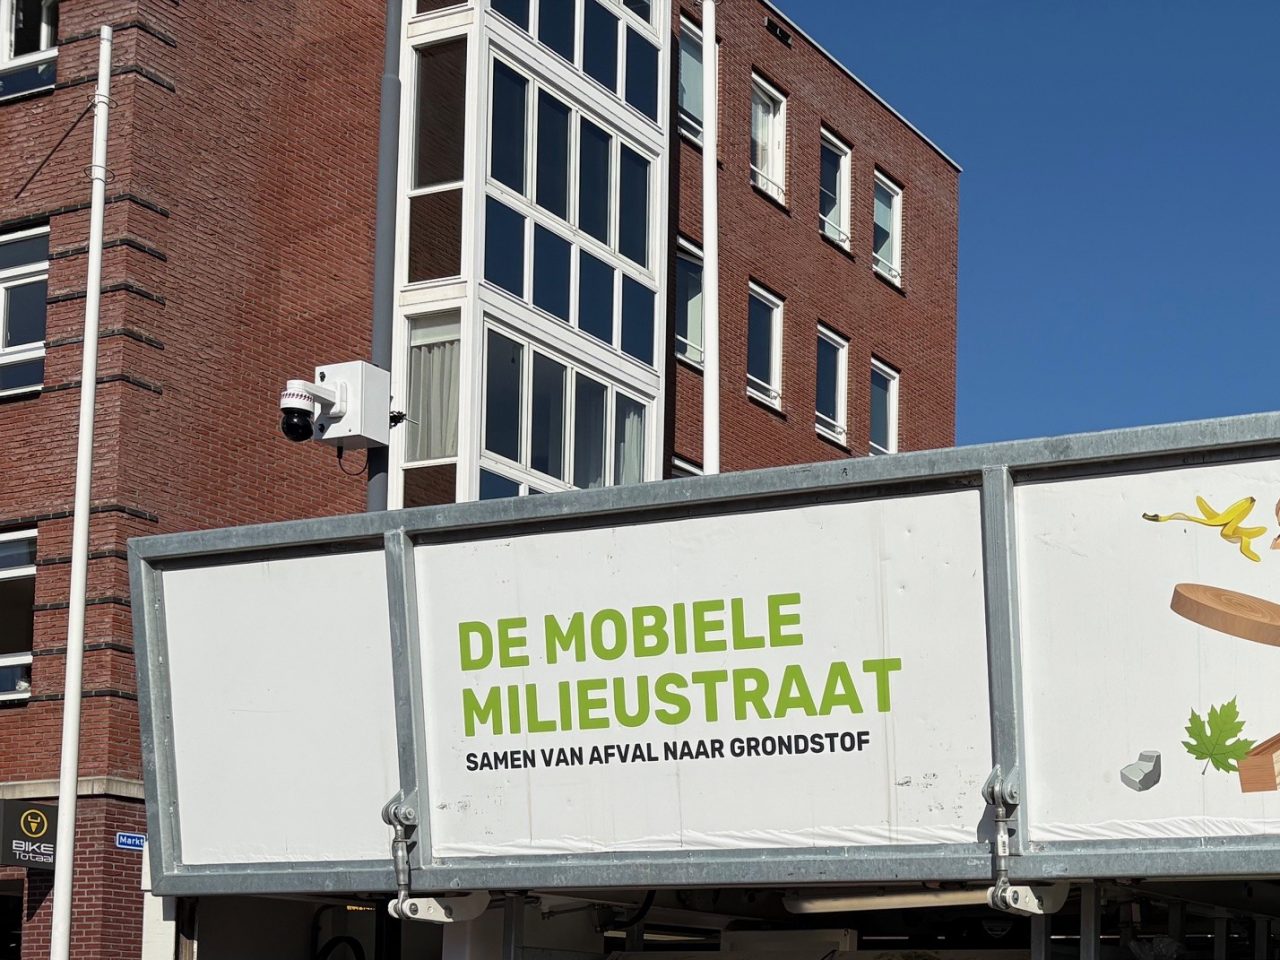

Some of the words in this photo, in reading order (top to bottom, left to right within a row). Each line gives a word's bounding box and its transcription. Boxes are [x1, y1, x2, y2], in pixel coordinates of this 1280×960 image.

[458, 616, 530, 671] DE
[544, 592, 804, 665] MOBIELE
[462, 657, 902, 737] MILIEUSTRAAT
[465, 748, 537, 772] SAMEN
[540, 745, 585, 768] VAN
[588, 742, 660, 766] AFVAL
[663, 738, 725, 761] NAAR
[729, 731, 871, 757] GRONDSTOF
[12, 840, 54, 854] BIKE
[119, 836, 144, 846] Markt
[13, 851, 54, 863] Totaal
